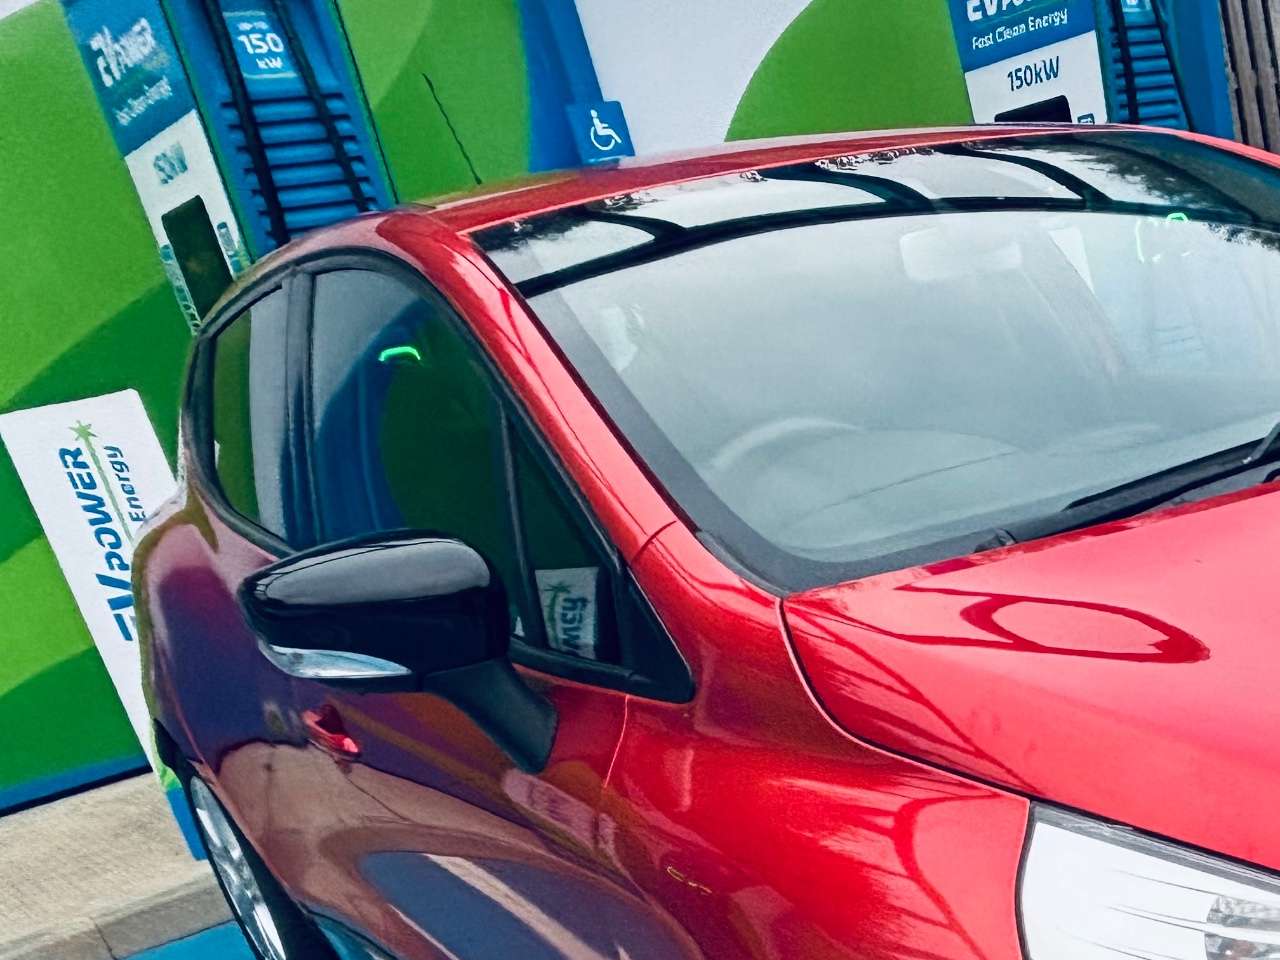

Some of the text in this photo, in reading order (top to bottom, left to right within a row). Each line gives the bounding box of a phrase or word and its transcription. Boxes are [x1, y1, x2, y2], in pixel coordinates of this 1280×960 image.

[1027, 8, 1069, 32] Energy
[237, 33, 284, 54] 150
[1007, 56, 1060, 92] 150kW
[58, 446, 130, 571] POWER
